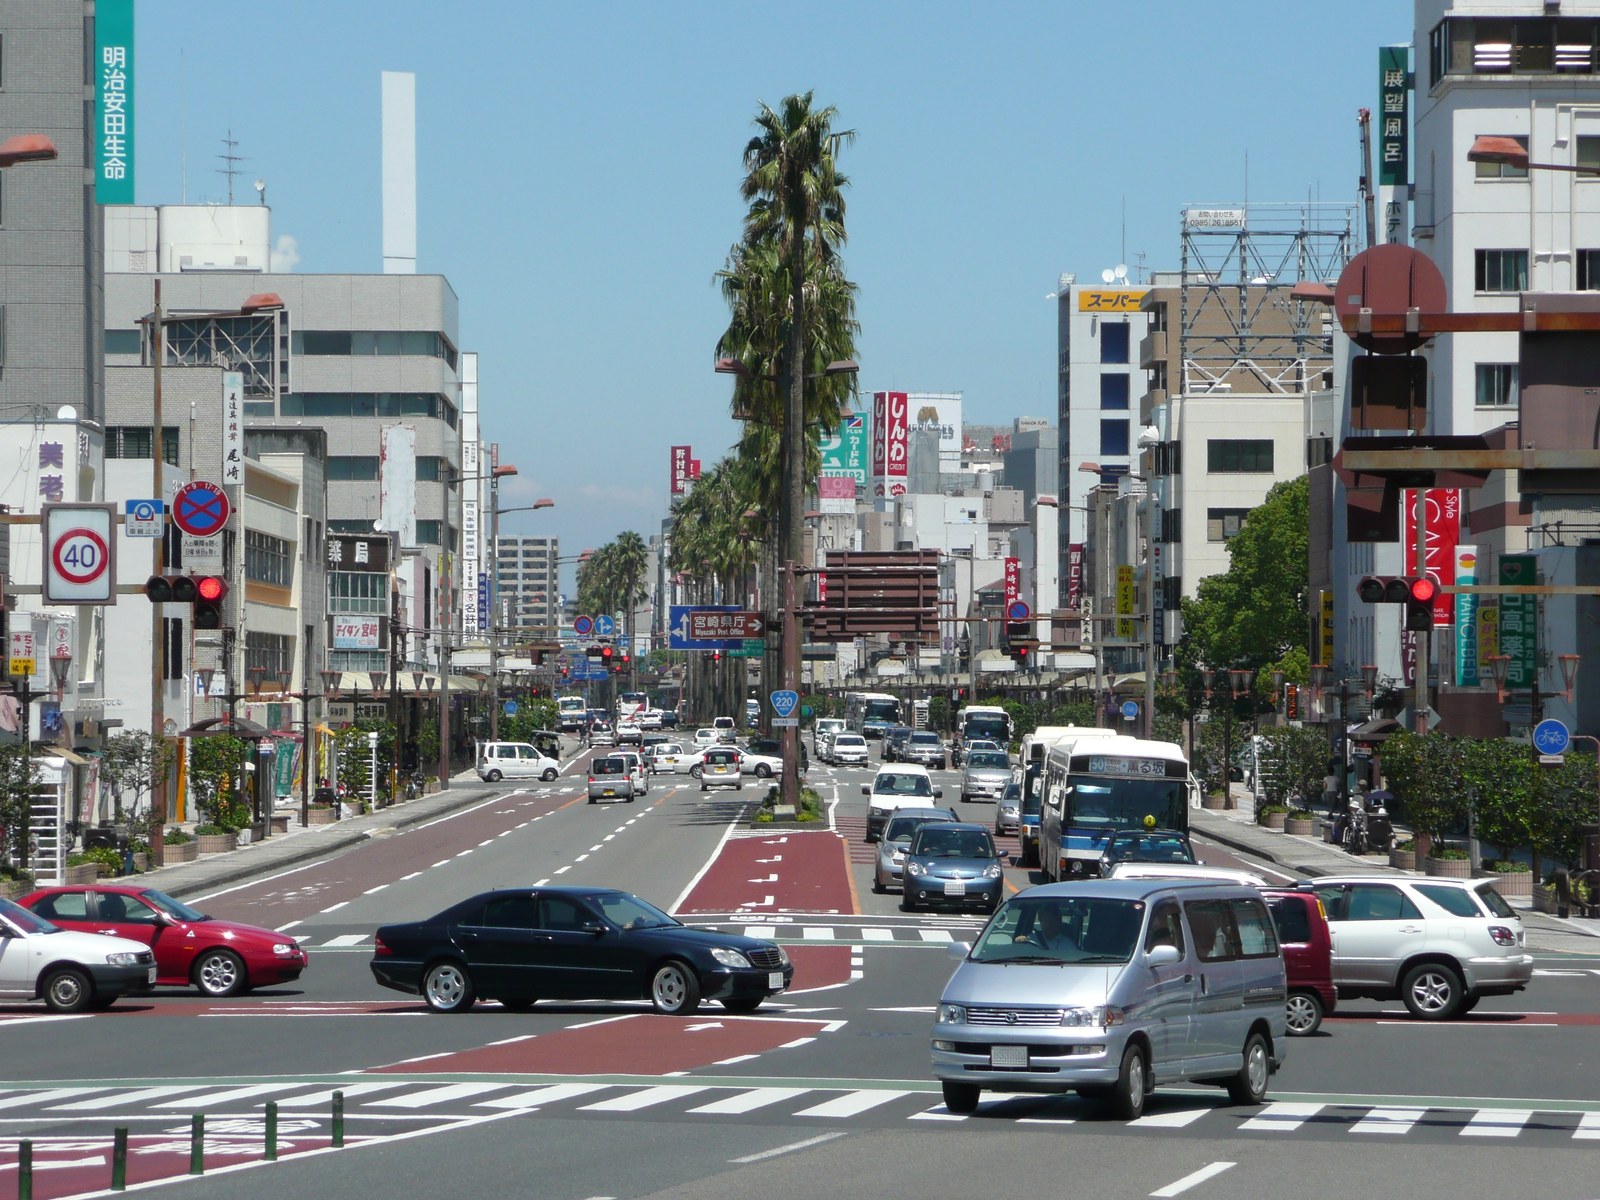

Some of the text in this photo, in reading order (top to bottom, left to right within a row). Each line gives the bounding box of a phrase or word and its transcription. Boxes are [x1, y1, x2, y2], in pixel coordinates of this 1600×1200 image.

[103, 46, 127, 181] 明治安田生命
[1384, 69, 1404, 163] 展望風呂
[1088, 294, 1141, 308] スーパー
[891, 397, 906, 461] しんわ
[39, 441, 64, 502] 美老
[889, 463, 906, 471] CREDIT
[1446, 496, 1457, 519] Style
[64, 545, 95, 568] 40
[694, 616, 745, 628] 宮崎県庁
[695, 629, 716, 637] Miyazaki
[1461, 583, 1476, 678] RANCEBED
[776, 696, 793, 707] 220
[1091, 757, 1104, 771] 50
